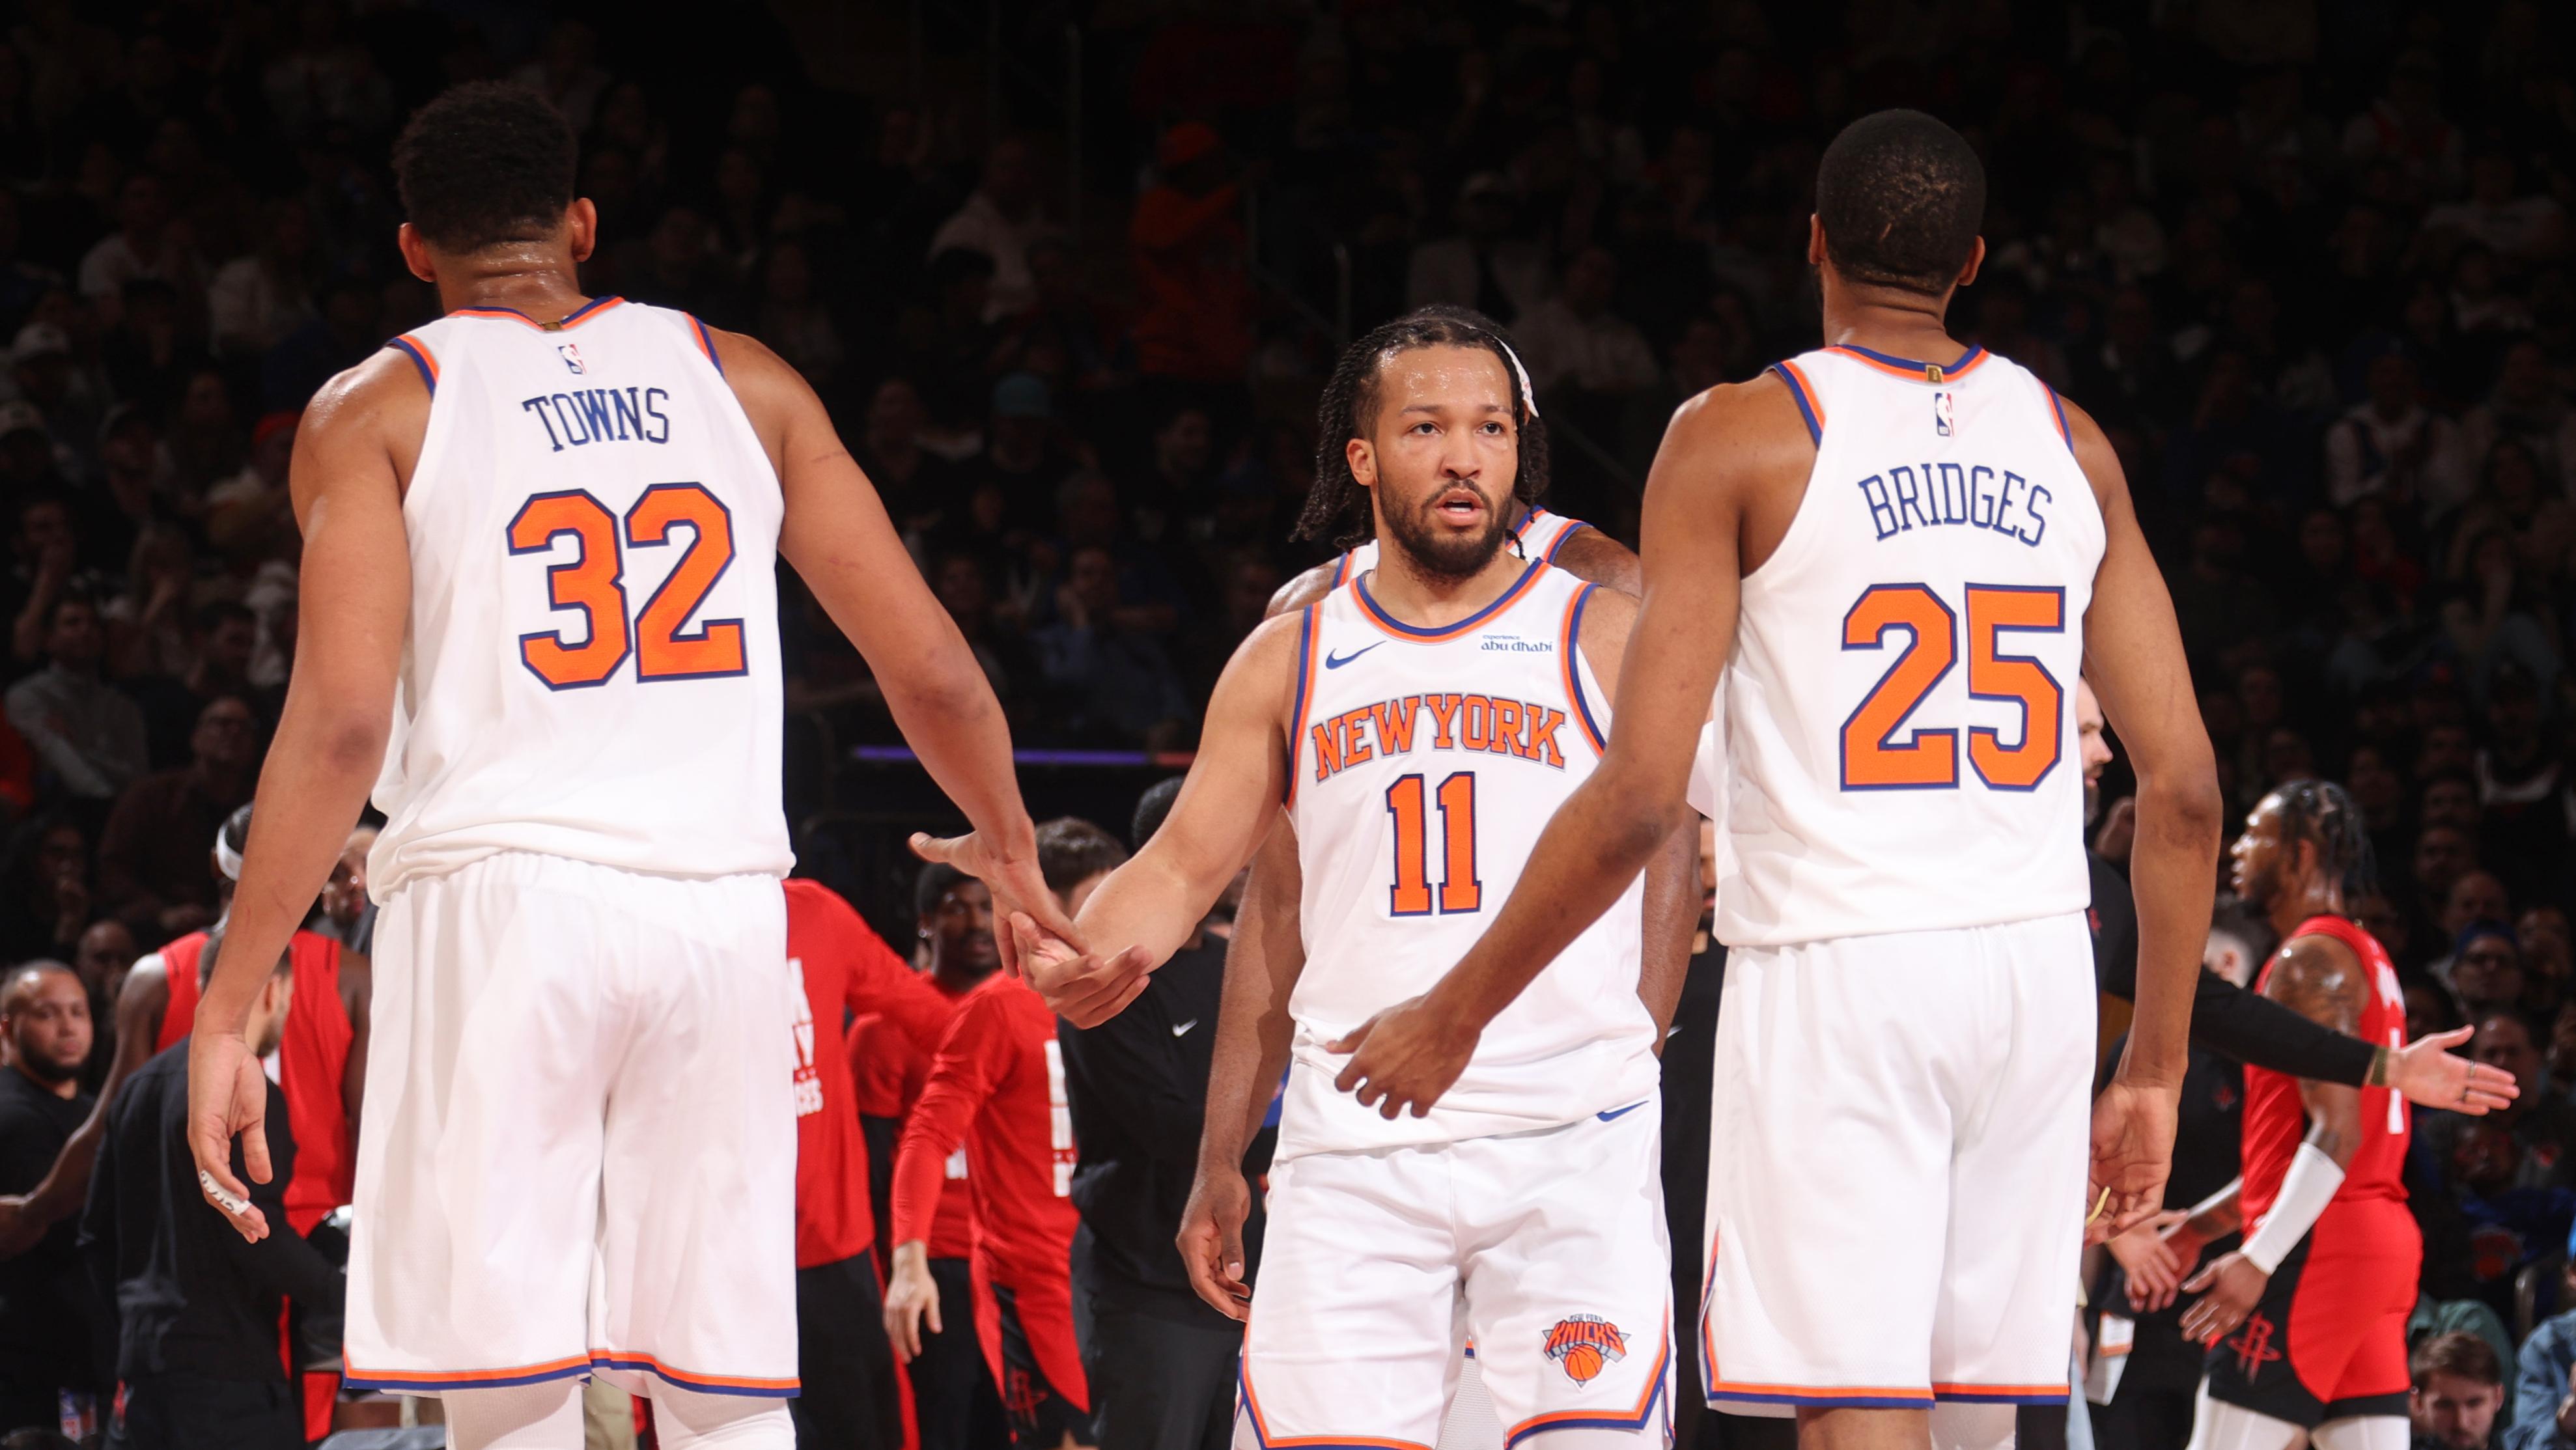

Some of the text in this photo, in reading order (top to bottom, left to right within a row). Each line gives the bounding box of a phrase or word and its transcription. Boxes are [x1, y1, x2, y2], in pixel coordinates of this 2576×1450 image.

[522, 387, 670, 453] TOWNS
[1857, 463, 2052, 547] BRIDGES
[506, 482, 749, 691] 32
[1481, 641, 1553, 652] abu dhabi
[1840, 582, 2065, 792] 25
[1311, 692, 1567, 784] NEW YORK
[1385, 771, 1482, 917] 11
[1543, 1319, 1627, 1358] KNICKS
